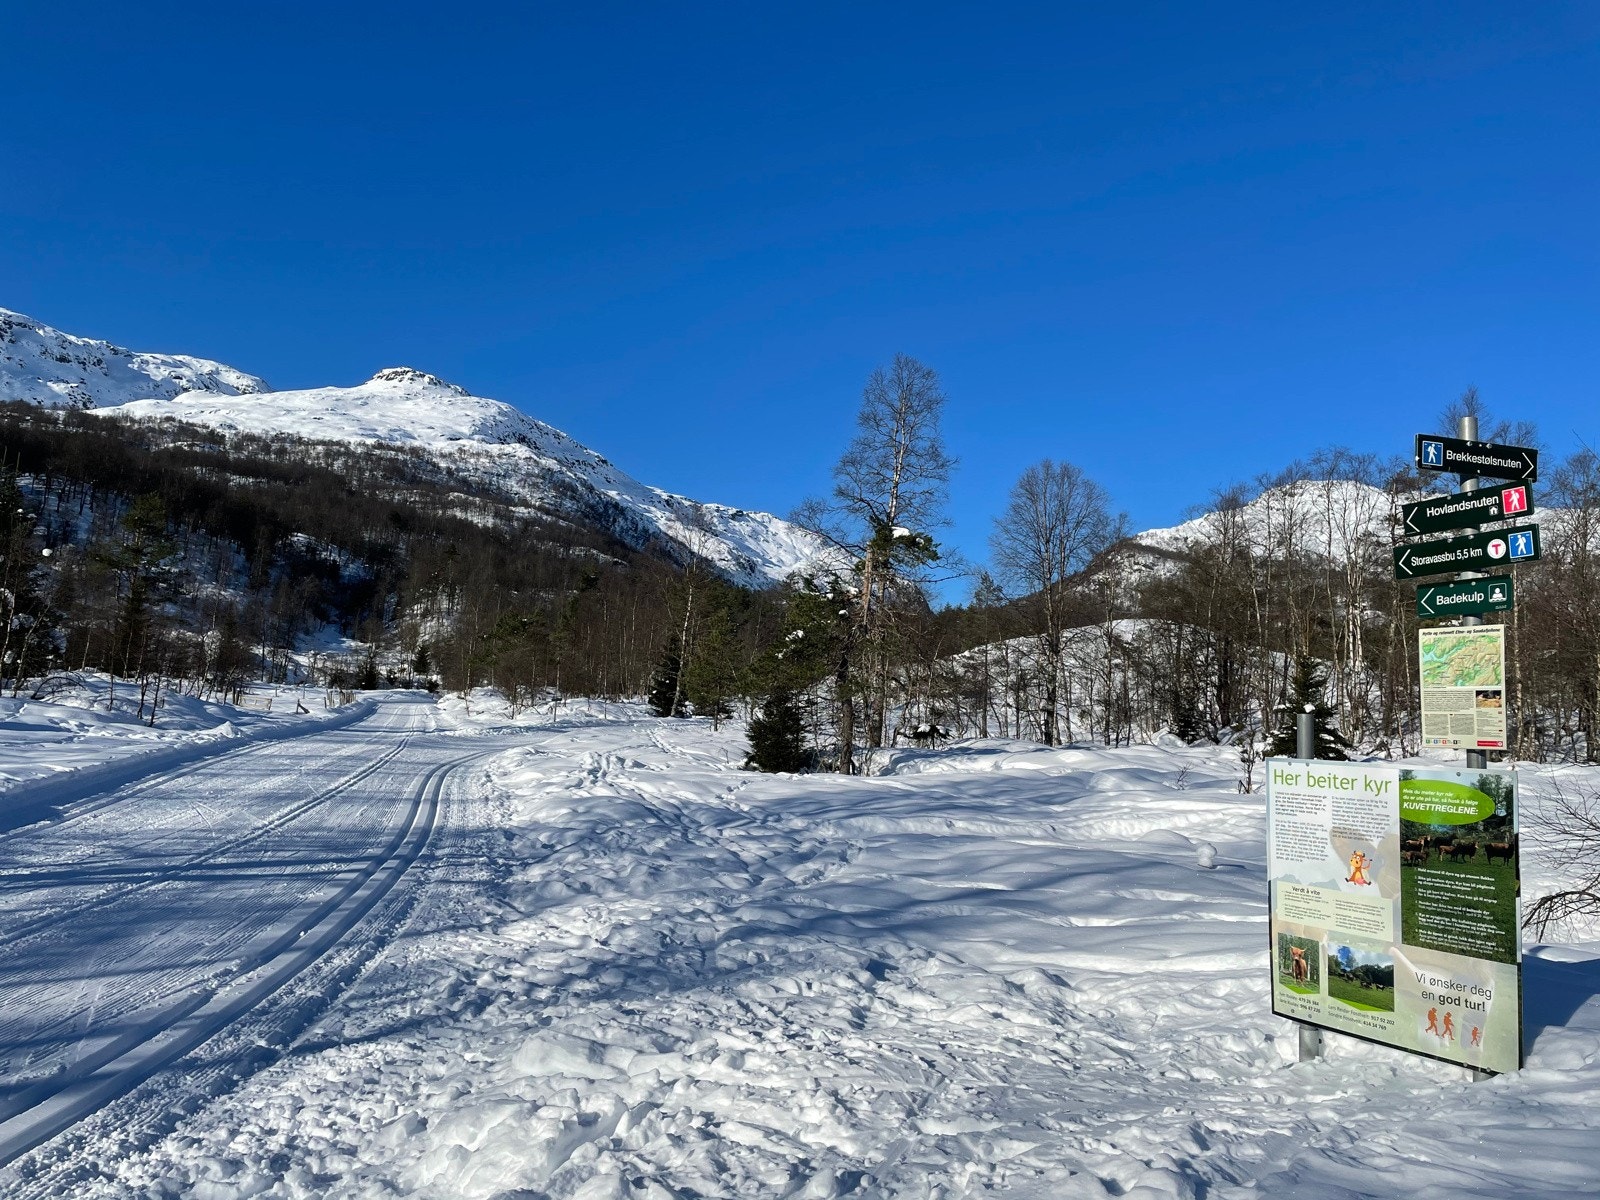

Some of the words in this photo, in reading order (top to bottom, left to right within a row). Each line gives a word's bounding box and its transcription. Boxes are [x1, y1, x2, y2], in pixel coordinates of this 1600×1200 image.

[1446, 450, 1522, 469] Brekkestølsnuten
[1426, 496, 1499, 517] Hovlandsnuten
[1411, 552, 1455, 566] Storavassbu
[1456, 550, 1469, 560] 5,5
[1470, 547, 1483, 557] km
[1436, 592, 1485, 605] Badekulp
[1273, 768, 1301, 786] Her
[1307, 771, 1358, 790] beiter
[1364, 774, 1392, 796] kyr
[1403, 802, 1479, 815] KUVETTREGLENE:
[1415, 971, 1426, 984] Vi
[1429, 977, 1467, 992] ønsker
[1470, 984, 1492, 1000] deg
[1421, 990, 1435, 1001] en
[1438, 994, 1461, 1007] god
[1464, 998, 1486, 1012] tur!
